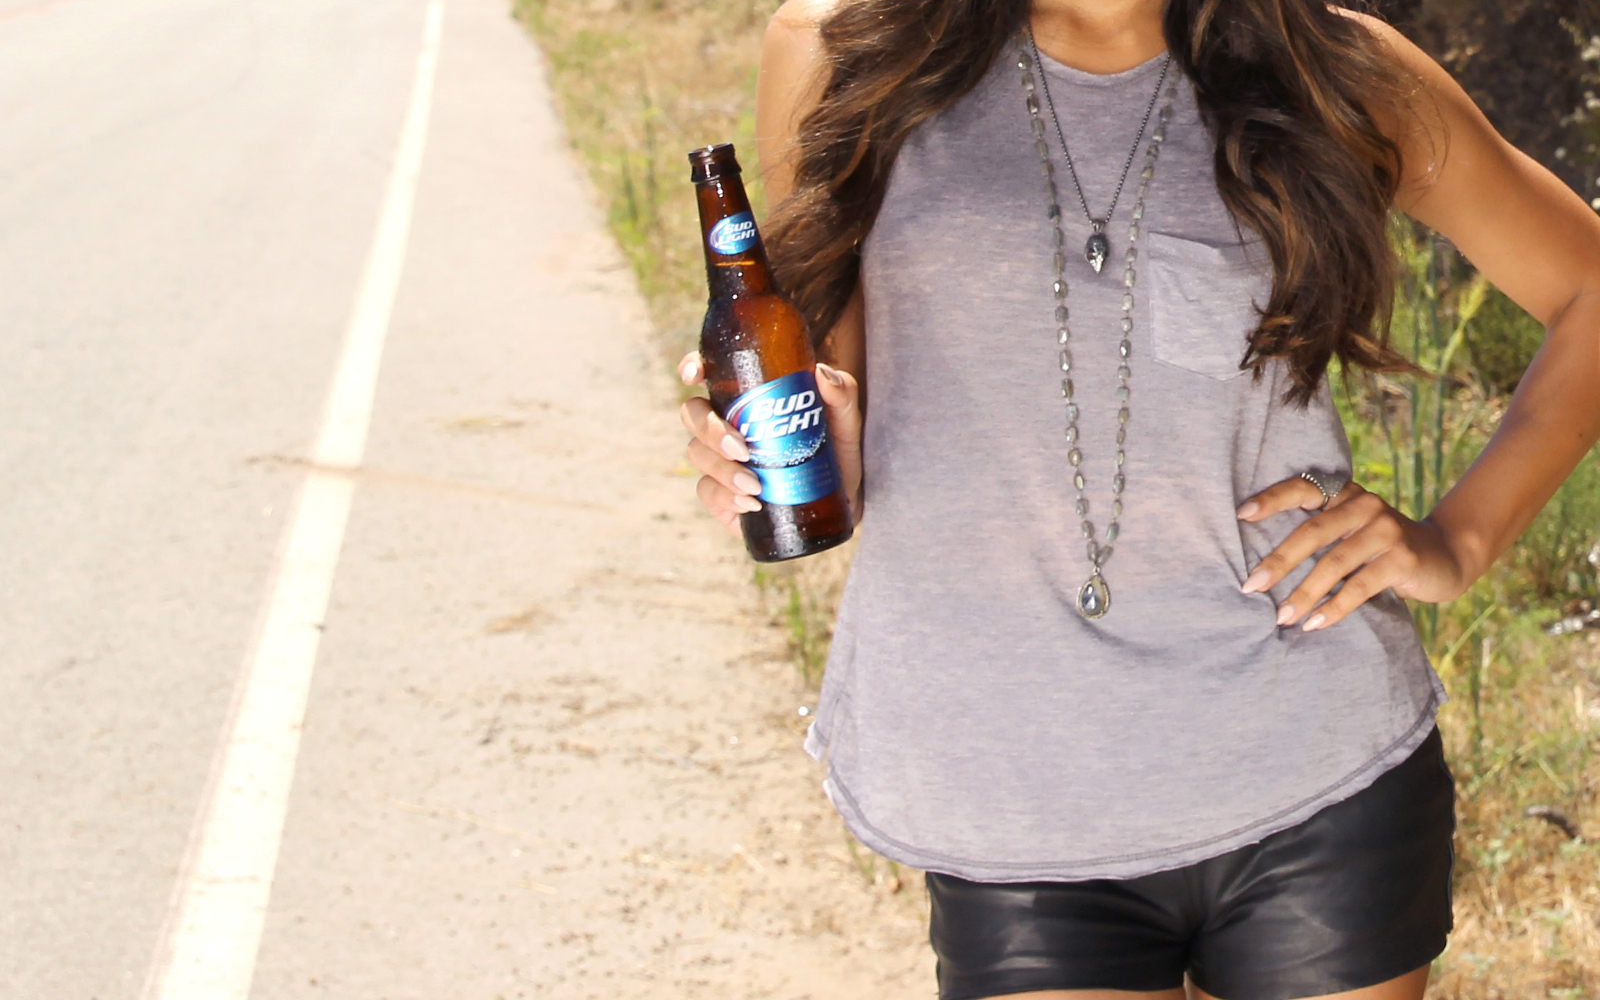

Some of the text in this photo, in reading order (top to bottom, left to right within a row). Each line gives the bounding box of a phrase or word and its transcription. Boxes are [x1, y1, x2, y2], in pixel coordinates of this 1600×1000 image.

[718, 229, 756, 245] LIGHT
[723, 221, 752, 235] BUD
[748, 390, 815, 422] BUD
[740, 406, 823, 442] LIGHT
